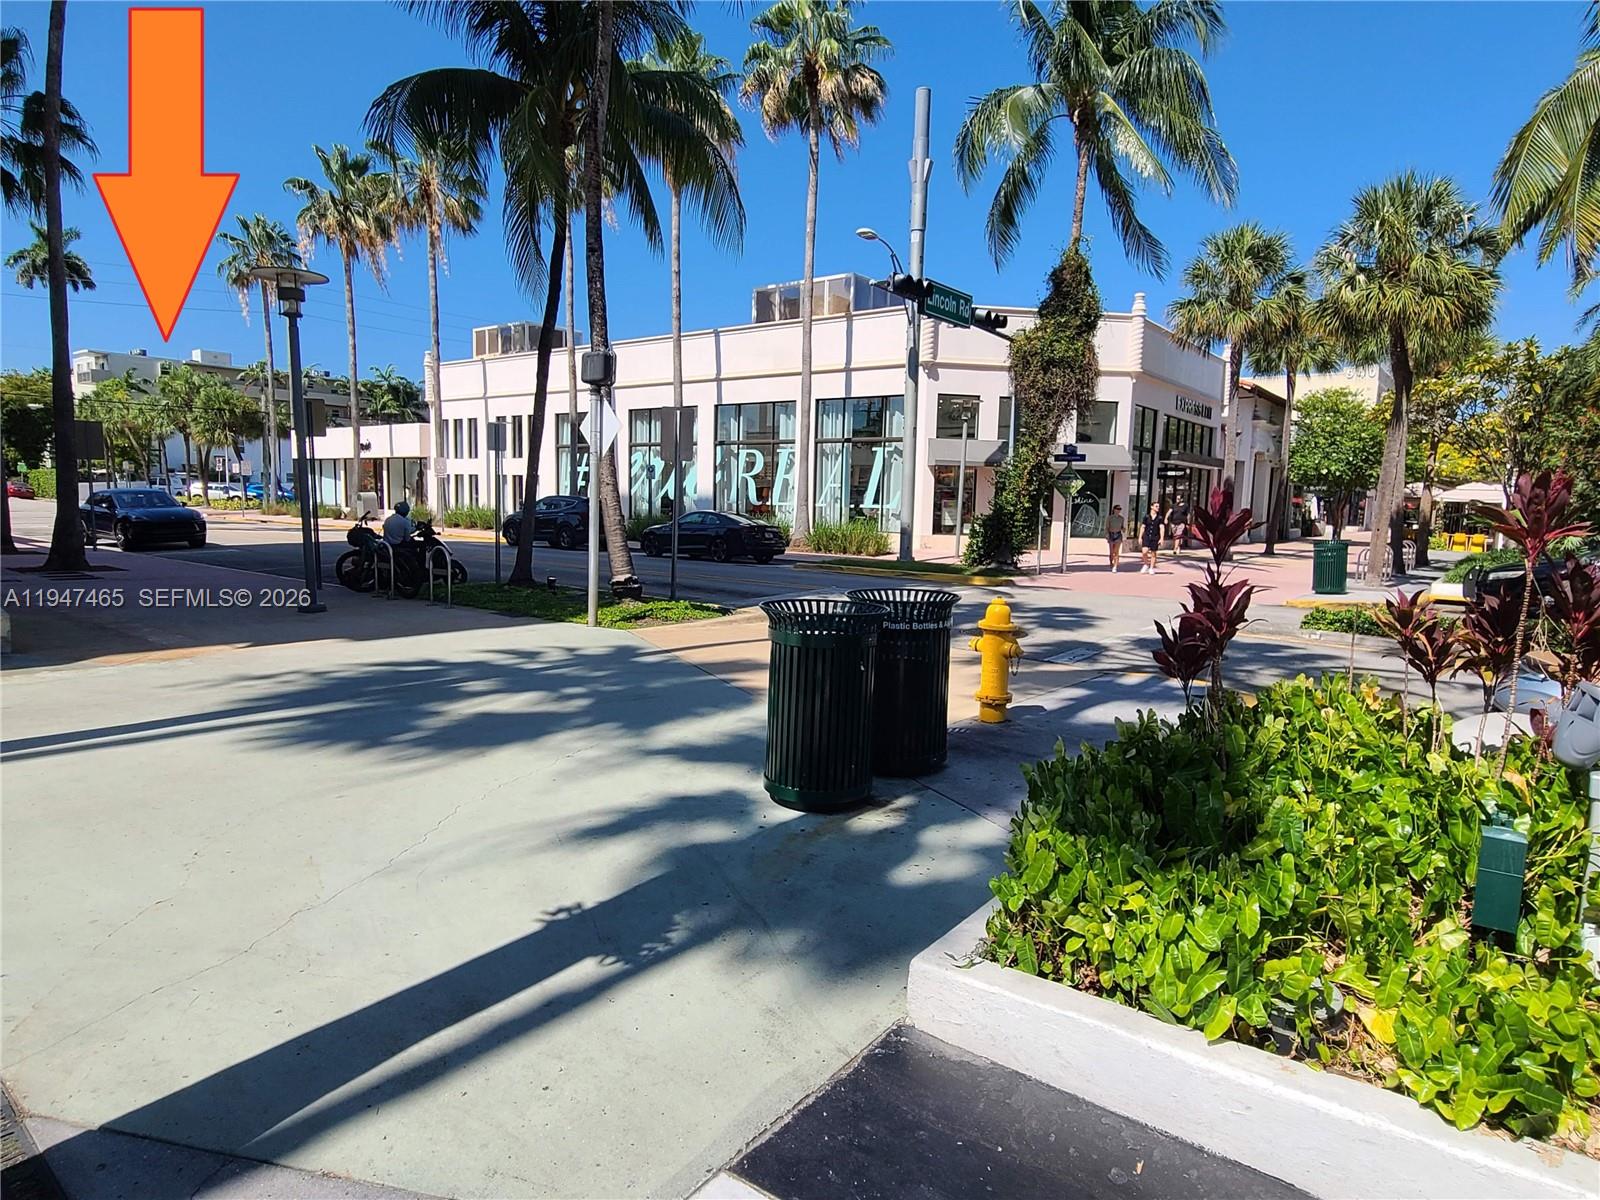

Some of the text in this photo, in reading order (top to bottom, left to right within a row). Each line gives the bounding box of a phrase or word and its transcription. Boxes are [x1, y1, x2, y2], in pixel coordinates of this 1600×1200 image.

[928, 291, 970, 317] Lincoln Rd
[882, 621, 910, 630] Plastic
[912, 621, 938, 630] Bottles
